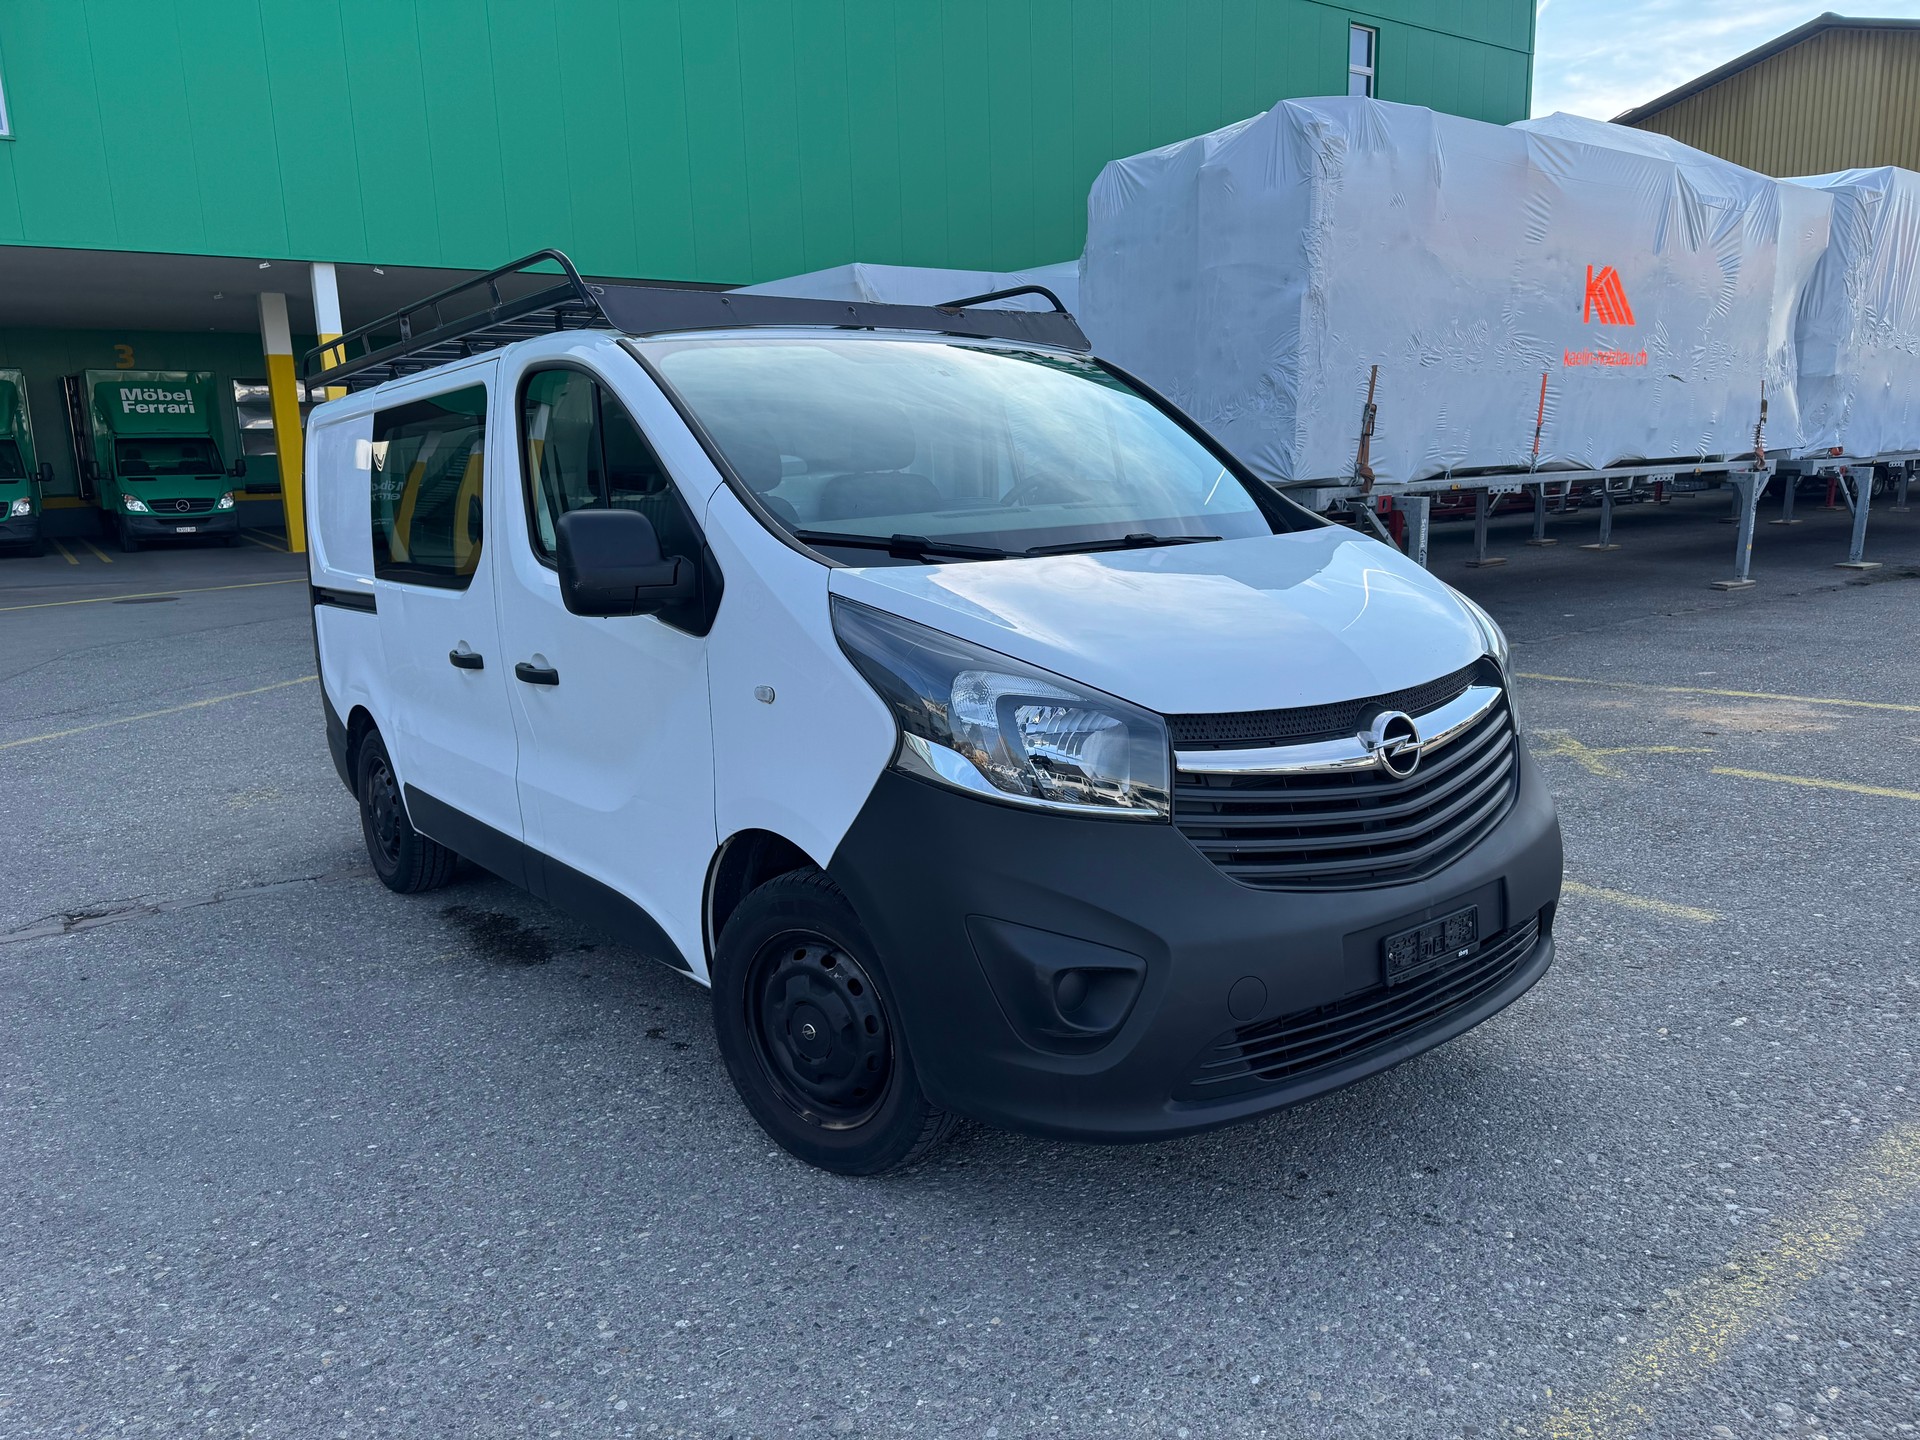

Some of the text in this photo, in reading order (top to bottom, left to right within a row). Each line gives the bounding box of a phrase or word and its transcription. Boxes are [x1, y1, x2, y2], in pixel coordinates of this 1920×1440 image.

[113, 344, 135, 369] 3
[119, 388, 193, 401] Möbel
[122, 400, 195, 414] Ferrari
